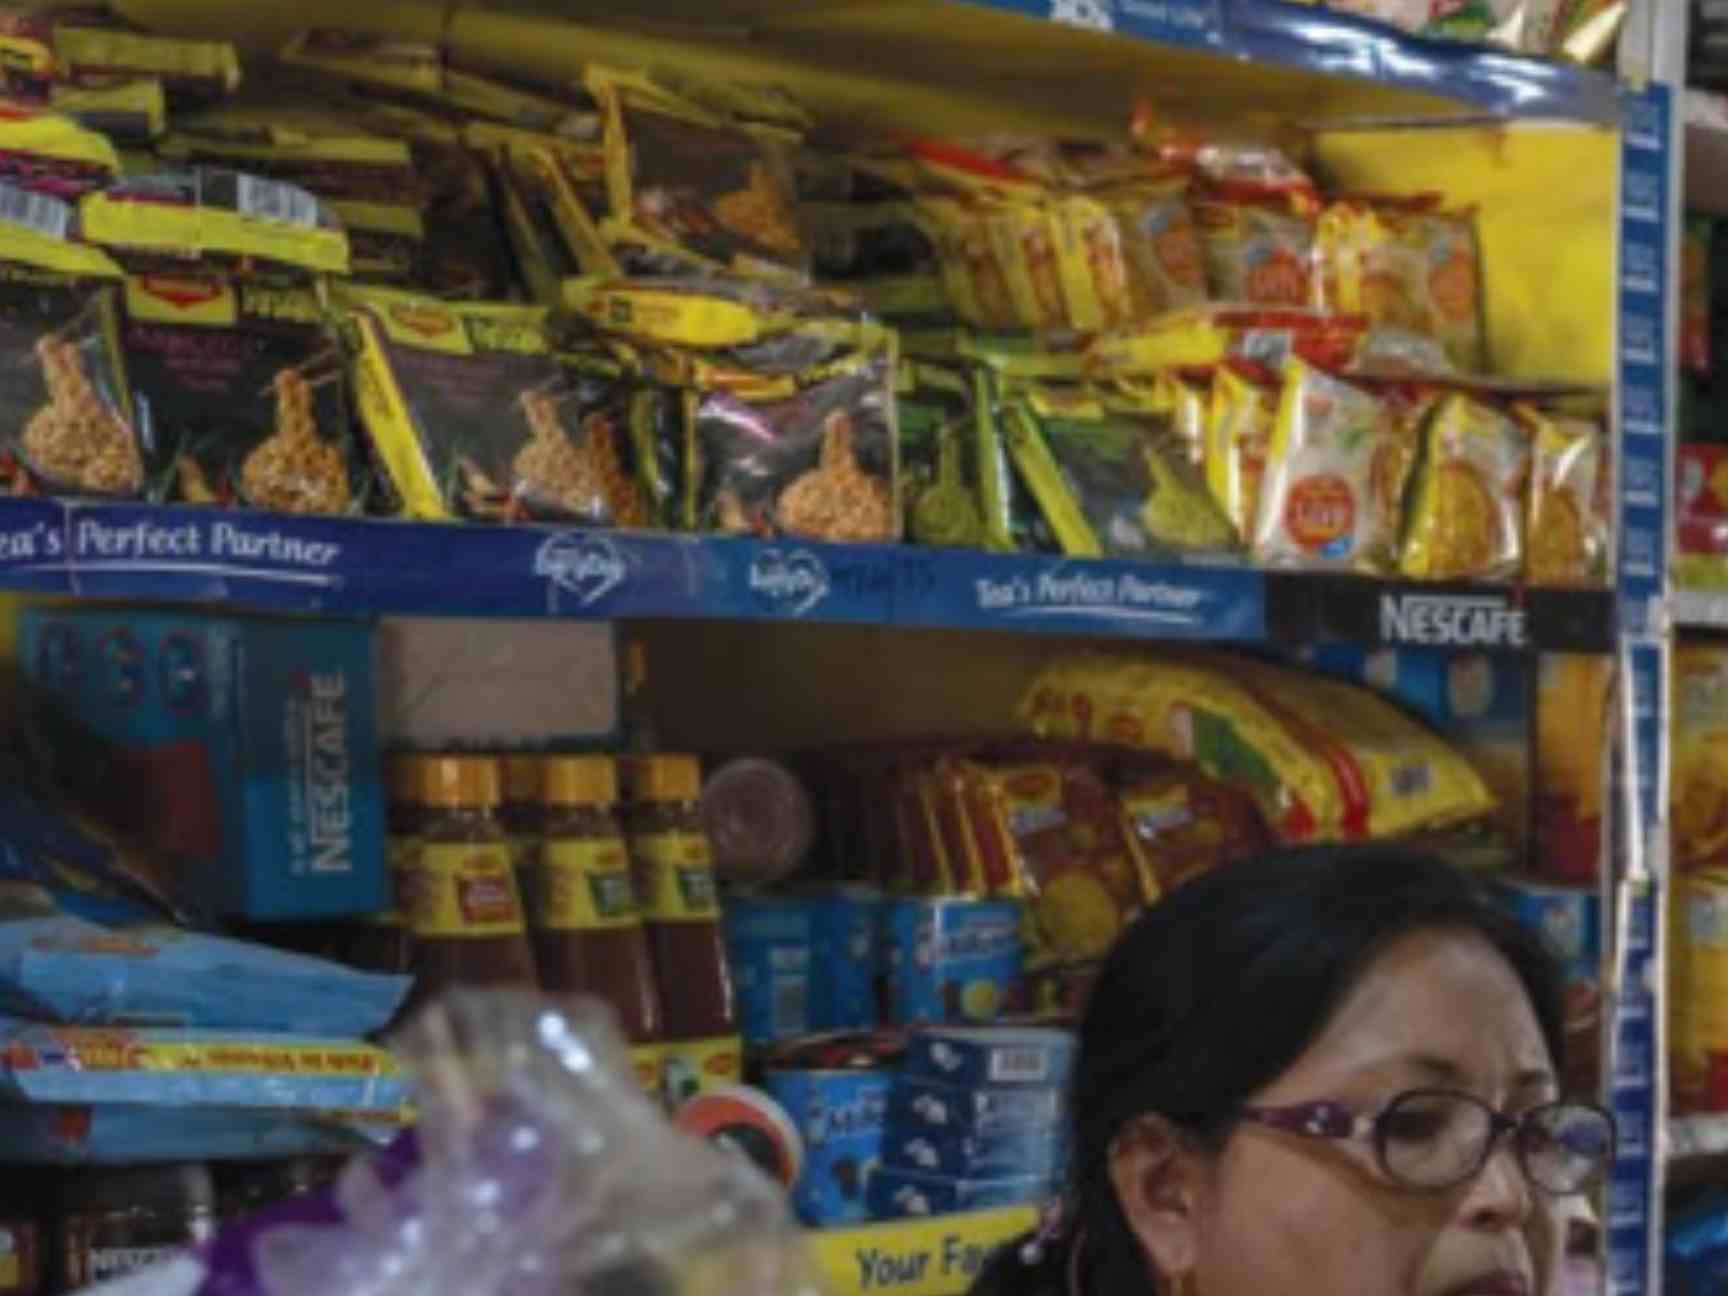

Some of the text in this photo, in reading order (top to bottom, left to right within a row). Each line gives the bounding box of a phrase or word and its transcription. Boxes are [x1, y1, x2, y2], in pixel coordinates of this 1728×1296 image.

[77, 519, 200, 557] Perfect
[211, 521, 341, 566] Partner
[1037, 573, 1114, 604] Perfect
[855, 1246, 931, 1291] Your
